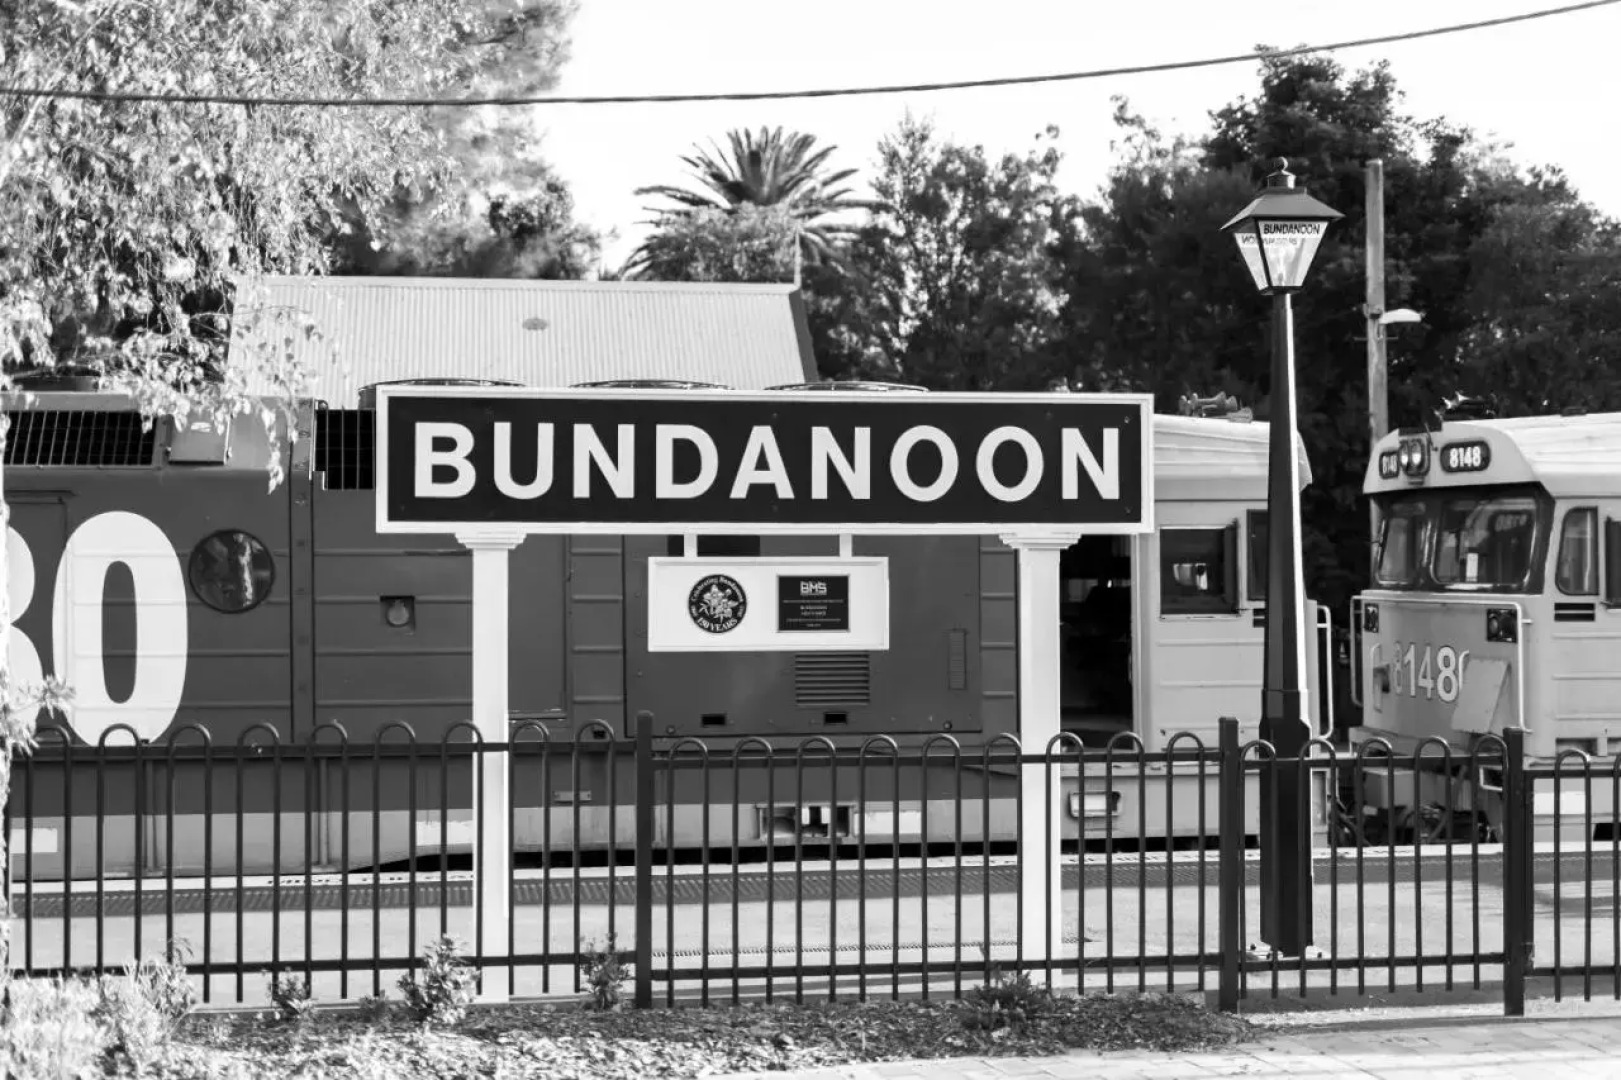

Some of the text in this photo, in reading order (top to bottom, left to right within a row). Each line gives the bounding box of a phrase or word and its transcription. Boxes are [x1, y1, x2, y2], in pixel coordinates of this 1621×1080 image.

[1263, 223, 1320, 235] BUNDANOON
[413, 421, 1121, 502] BUNDANOON
[1449, 446, 1482, 468] 8148
[800, 581, 827, 595] BMS
[710, 617, 738, 632] YEARS
[1393, 640, 1460, 703] 8148
